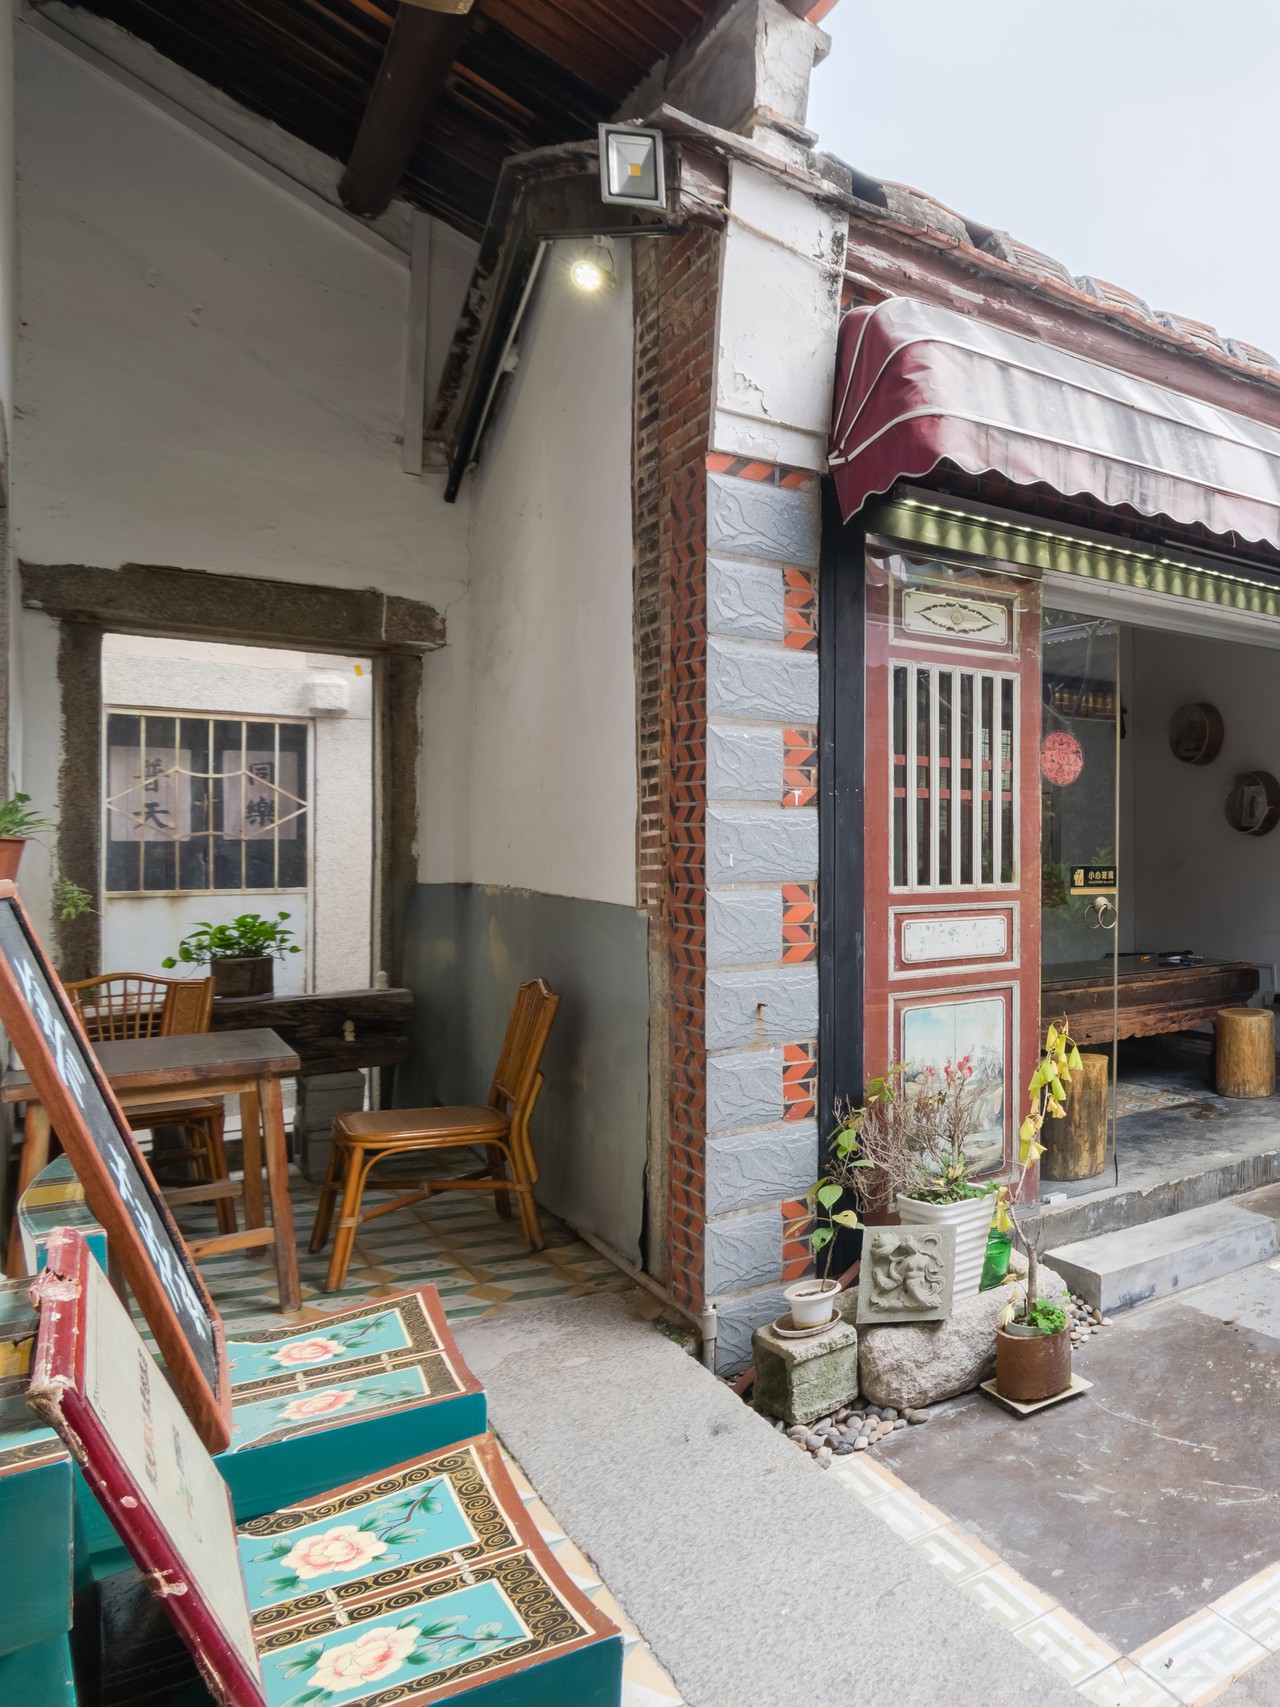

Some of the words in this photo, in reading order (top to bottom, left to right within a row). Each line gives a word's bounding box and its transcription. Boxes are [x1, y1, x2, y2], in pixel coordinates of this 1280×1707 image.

[132, 757, 176, 831] 普天
[245, 760, 277, 827] 同樂
[1088, 870, 1114, 880] 小心玻璃
